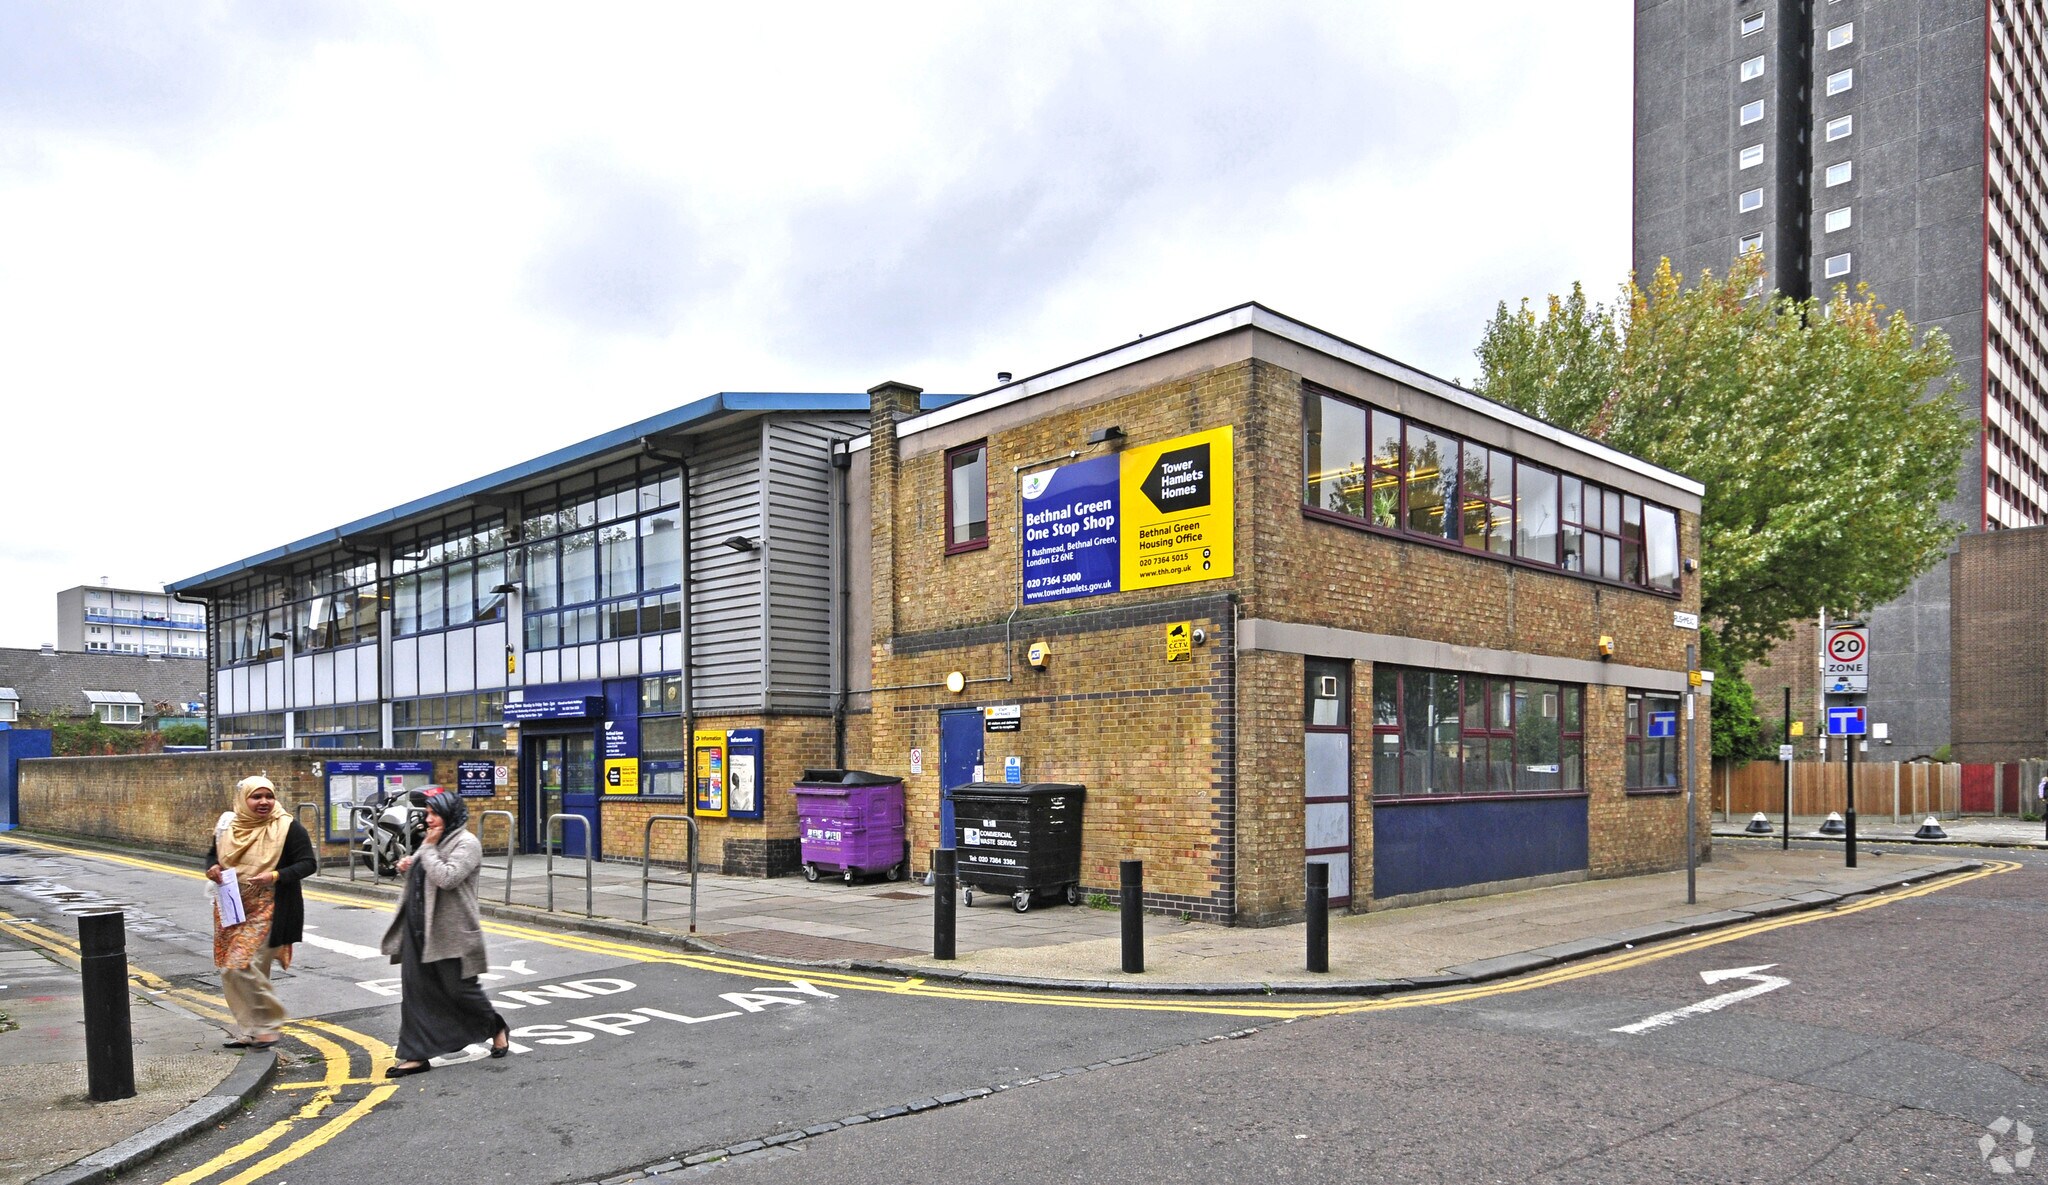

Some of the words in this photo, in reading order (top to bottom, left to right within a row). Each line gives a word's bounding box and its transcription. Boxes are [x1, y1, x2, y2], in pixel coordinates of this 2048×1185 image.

[1162, 460, 1193, 474] Tower
[1162, 470, 1203, 487] Hamlets
[1162, 485, 1196, 499] Homes
[1027, 504, 1070, 526] Bethnal
[1074, 500, 1111, 516] Green
[1027, 528, 1049, 541] One
[1052, 522, 1079, 536] Stop
[1083, 515, 1114, 530] Shop
[1140, 526, 1171, 539] Bethnal
[1174, 522, 1200, 533] Green
[1032, 544, 1065, 556] Rushmead,
[1067, 538, 1092, 550] Bethnal
[1094, 536, 1117, 545] Green,
[1140, 539, 1173, 550] Housing
[1176, 533, 1202, 544] Office
[1027, 558, 1049, 567] London
[1061, 552, 1073, 561] 6NE
[1154, 556, 1169, 564] 7364
[1172, 553, 1188, 561] 5015
[1140, 565, 1191, 577] www.thh.org.uk
[1027, 579, 1040, 588] 020
[1042, 575, 1060, 585] 7364
[1063, 572, 1081, 582] 5000
[1027, 580, 1111, 599] www.towerhamlets.gov.uk
[1834, 640, 1859, 652] 20
[1829, 664, 1863, 672] ZONE
[980, 830, 1012, 838] COMMERCIAL
[997, 839, 1017, 847] SERVICE
[355, 960, 538, 996] PY
[489, 978, 637, 1009] ND
